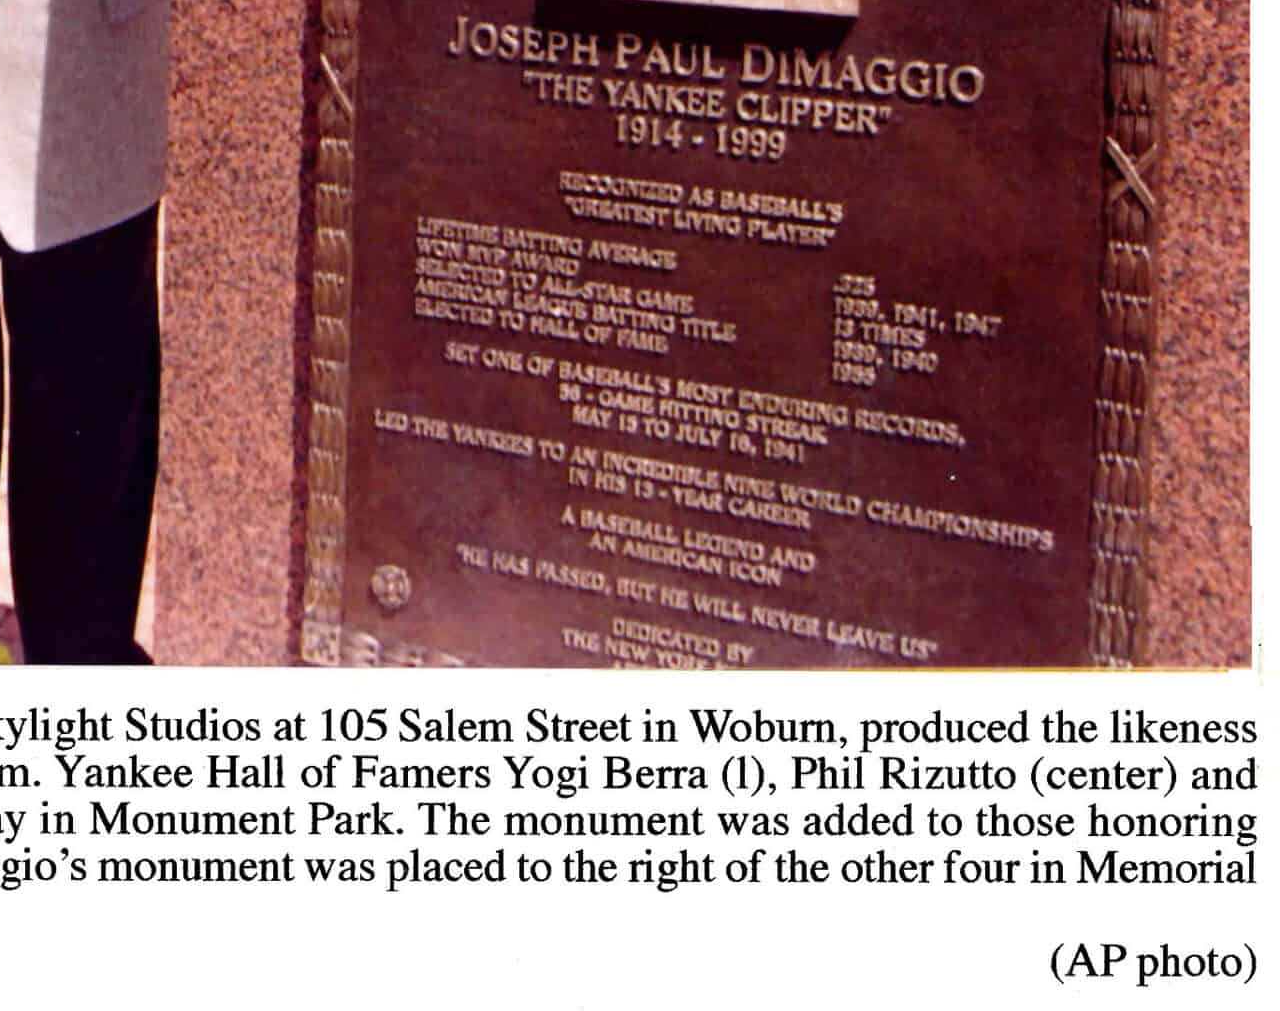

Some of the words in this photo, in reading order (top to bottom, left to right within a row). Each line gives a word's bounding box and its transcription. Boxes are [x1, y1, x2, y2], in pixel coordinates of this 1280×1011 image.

[448, 16, 599, 66] JOSEPH
[615, 33, 725, 78] PAUL
[523, 70, 594, 105] "THE
[603, 79, 726, 118] YANKEE
[736, 92, 892, 134] CLIPPER"
[617, 114, 683, 148] 1914
[716, 125, 787, 159] 1999
[672, 212, 741, 236] LIVING
[689, 188, 714, 207] AS
[720, 191, 843, 223] BASEBALL'S
[416, 238, 461, 259] WON
[509, 253, 580, 277] AWARD
[417, 217, 499, 244] LIFETIME
[503, 230, 582, 257] BATTING
[587, 245, 678, 270] AVERAGE
[415, 258, 505, 287] SELECTED
[510, 270, 536, 289] TO
[636, 291, 694, 314] GAME
[415, 278, 511, 309] AMERICAN
[513, 295, 587, 320] LEAGUE
[592, 305, 675, 334] BATTING
[679, 318, 736, 341] TITLE
[415, 298, 492, 325] ELECTED
[497, 312, 524, 330] TO
[530, 317, 580, 340] HALL
[584, 326, 612, 345] OF
[617, 330, 668, 353] FAME
[860, 321, 925, 348] TIMES
[444, 342, 477, 364] SET
[482, 349, 521, 372] ONE
[527, 356, 555, 377] OF
[559, 360, 670, 395] BASEBALL'S
[677, 379, 733, 405] MOST
[738, 391, 849, 427] ENDURING
[854, 408, 966, 446] RECORDS,
[599, 390, 654, 413] GAME
[659, 400, 740, 428] HITTING
[746, 414, 828, 444] STREAK
[573, 405, 612, 429] MAY
[642, 417, 670, 437] TO
[675, 423, 722, 446] JULY
[375, 409, 408, 431] LED
[412, 417, 449, 440] THE
[452, 423, 532, 456] YANKEES
[538, 440, 566, 460] TO
[570, 446, 596, 466] AN
[603, 451, 719, 489] INCREDIBLE
[724, 473, 778, 497] NINE
[780, 482, 862, 517] WORLD
[866, 500, 1055, 551] CHAMPIONSHIPS
[569, 467, 588, 486] IN
[594, 473, 626, 494] HIS
[672, 484, 723, 512] YEAR
[728, 496, 811, 530] CAREER
[561, 505, 575, 526] A
[580, 508, 678, 543] BASEBALL
[684, 530, 765, 561] LEGEND
[769, 548, 816, 572] AND
[590, 533, 616, 551] AN
[622, 538, 722, 575] AMERICAN
[729, 561, 782, 586] ICON
[492, 552, 529, 576] HAS
[616, 579, 655, 604] BUT
[660, 587, 689, 609] HE
[693, 593, 747, 621] WILL
[752, 606, 820, 638] NEVER
[827, 620, 895, 652] LEAVE
[561, 628, 599, 652] THE
[604, 636, 651, 662] NEW
[613, 617, 720, 658] DEDICATED
[726, 643, 755, 663] BY
